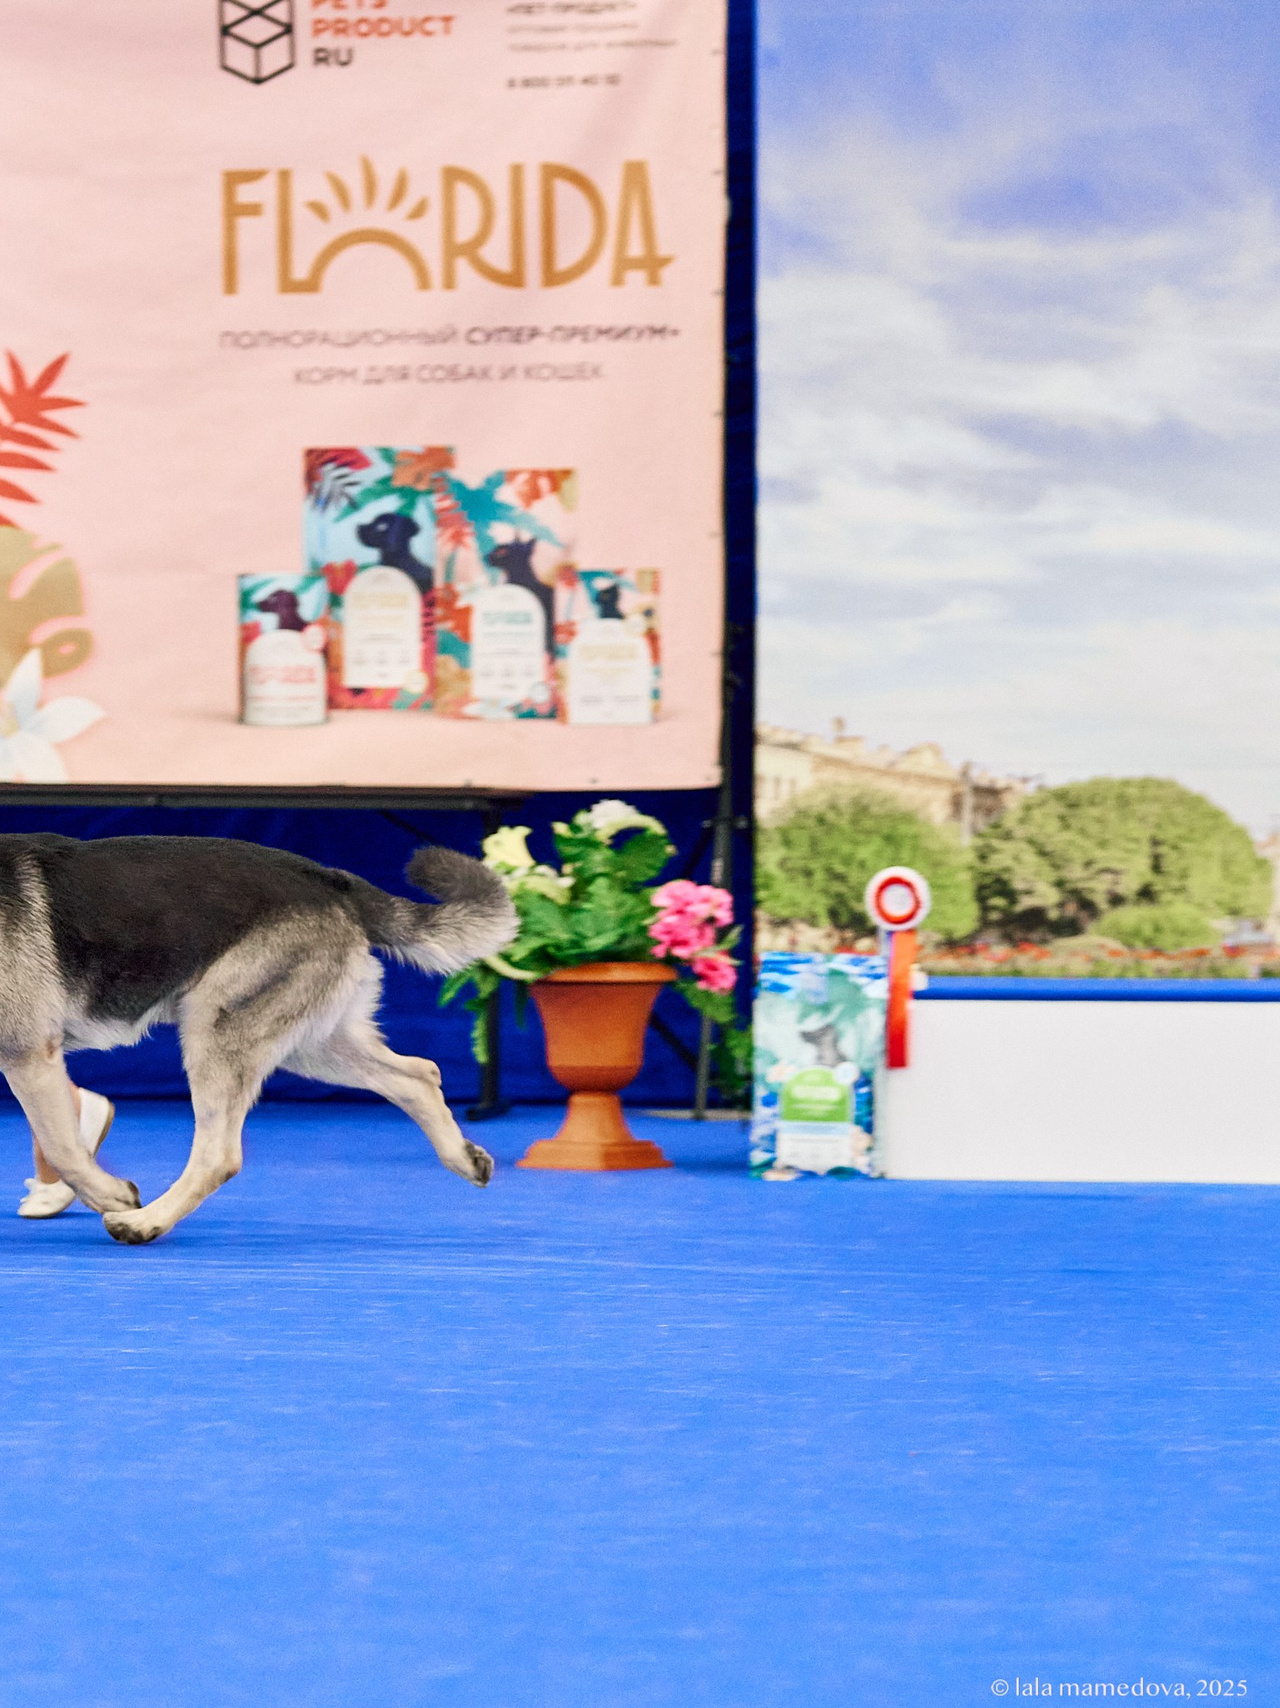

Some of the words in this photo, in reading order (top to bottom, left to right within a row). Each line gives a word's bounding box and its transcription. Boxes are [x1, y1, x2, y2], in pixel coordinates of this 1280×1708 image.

[311, 15, 455, 37] PRODUCT
[313, 47, 353, 67] RU
[221, 155, 677, 295] FLORIDA
[294, 366, 357, 385] КОРМ
[363, 365, 410, 385] ДЛЯ
[417, 363, 492, 383] СОБАК
[498, 364, 517, 381] И
[523, 362, 602, 382] КОШЕК
